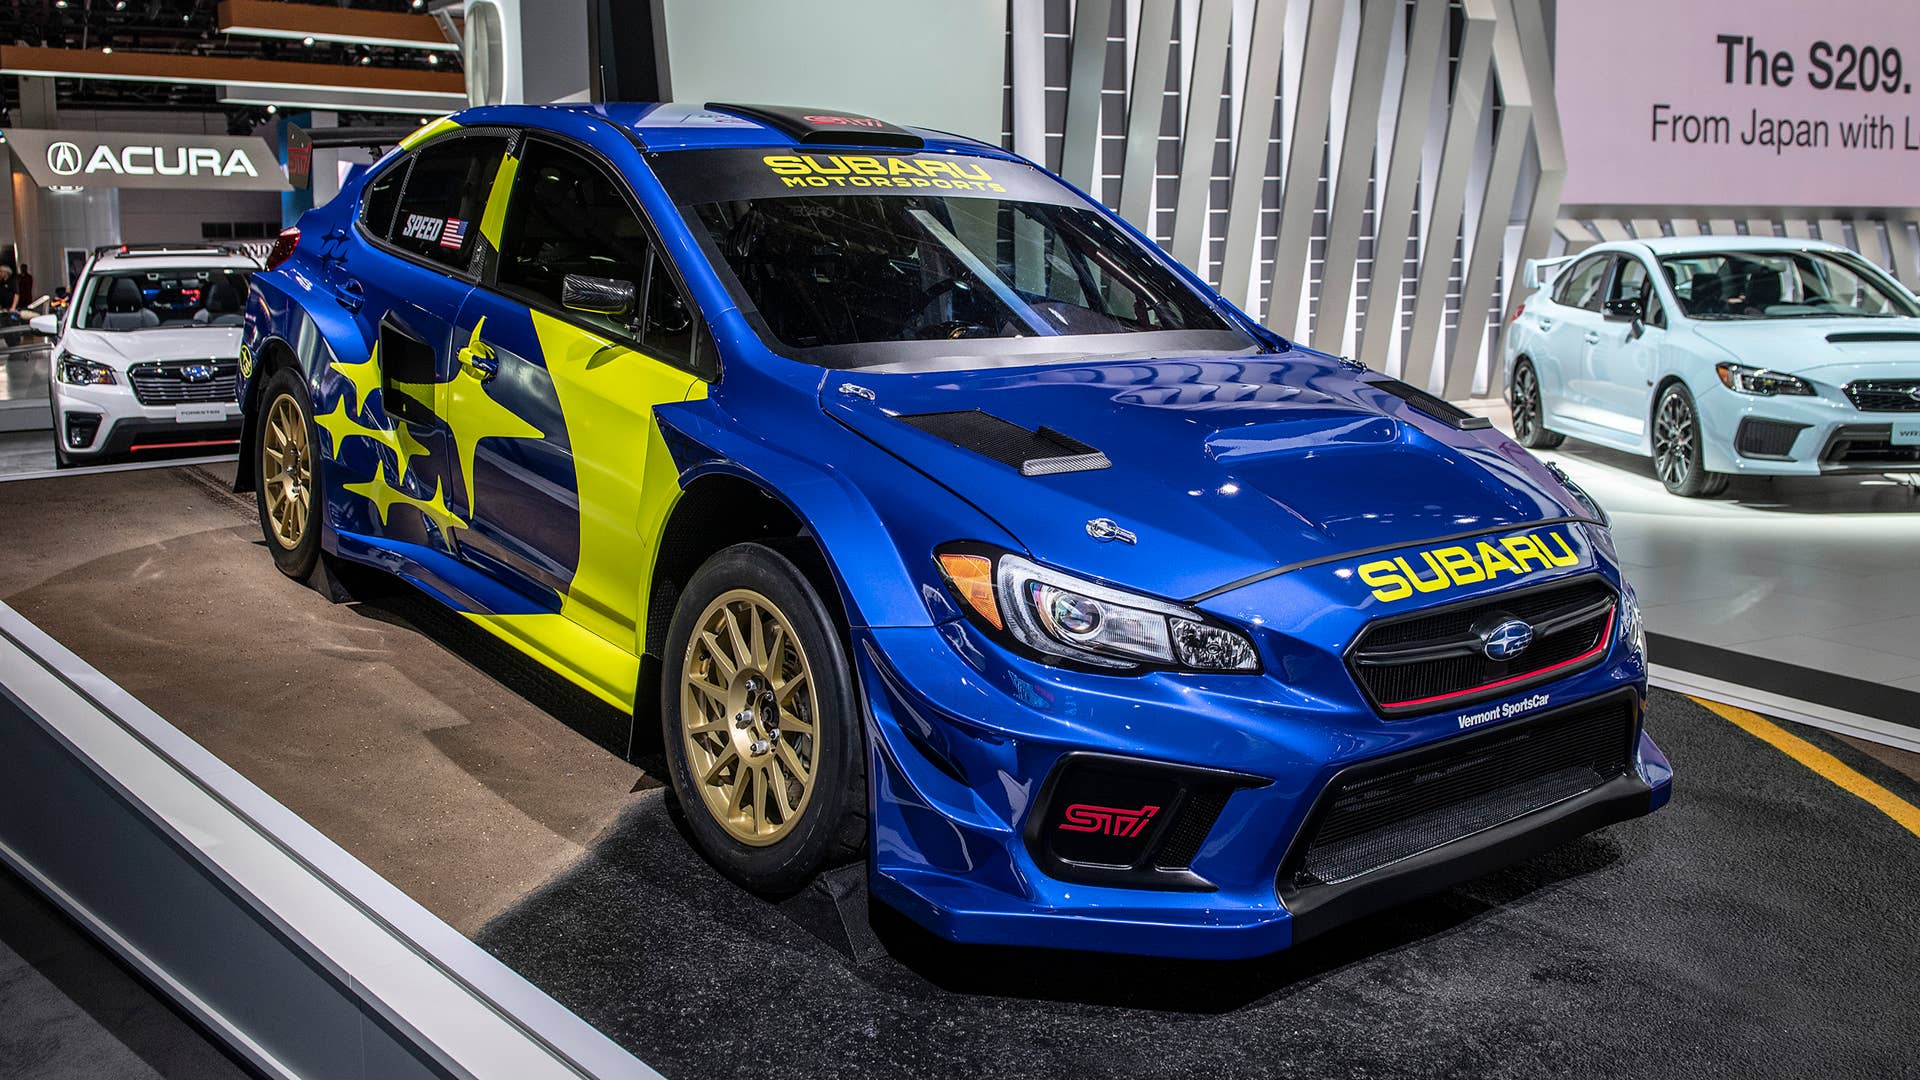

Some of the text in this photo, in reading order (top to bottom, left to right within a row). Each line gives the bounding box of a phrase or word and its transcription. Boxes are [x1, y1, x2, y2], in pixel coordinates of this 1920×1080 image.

[1717, 34, 1911, 94] The S209.
[1652, 104, 1920, 155] From Japan with L
[85, 145, 259, 177] ACURA
[763, 155, 993, 182] SUBARU
[780, 176, 1007, 193] MOTORSPORTS
[402, 214, 443, 241] SPEED
[1357, 531, 1579, 603] SUBARU
[1457, 694, 1550, 729] Vermont SportsCar
